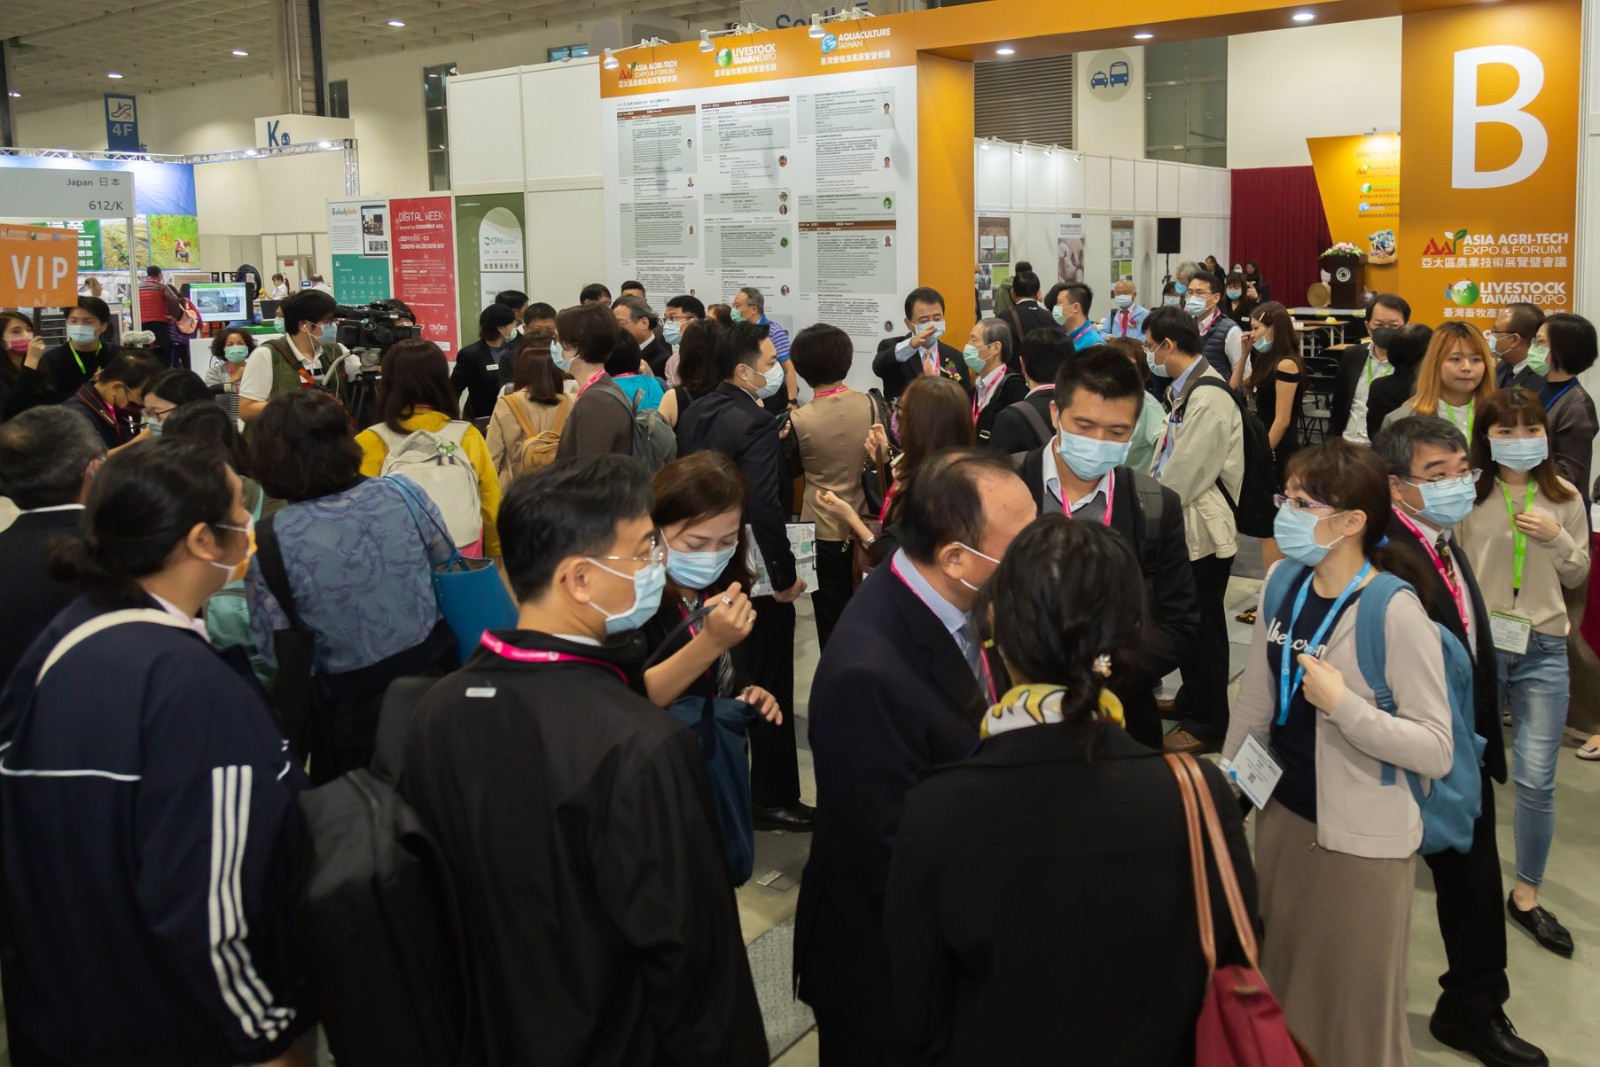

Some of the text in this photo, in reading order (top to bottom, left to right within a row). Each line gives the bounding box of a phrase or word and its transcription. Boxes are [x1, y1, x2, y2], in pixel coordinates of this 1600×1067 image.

[838, 28, 891, 41] AQUACULTURE
[732, 43, 776, 57] LIVESTOCK
[838, 40, 863, 49] TAIWAN
[635, 60, 678, 72] ASIA AGRI-TECH
[635, 70, 650, 78] EXPO
[1452, 45, 1548, 189] B
[112, 123, 134, 136] 4F
[267, 120, 281, 149] K
[67, 177, 121, 187] Japan 日本
[89, 200, 124, 211] 612/K
[398, 210, 444, 222] DIGITAL WEEK
[1463, 233, 1568, 245] ASIA AGRI-TECH
[1463, 245, 1562, 255] EXPO & FORUM
[11, 255, 68, 290] VIP
[1480, 282, 1566, 294] LIVESTOCK
[1480, 294, 1567, 305] TAIWAN EXPO
